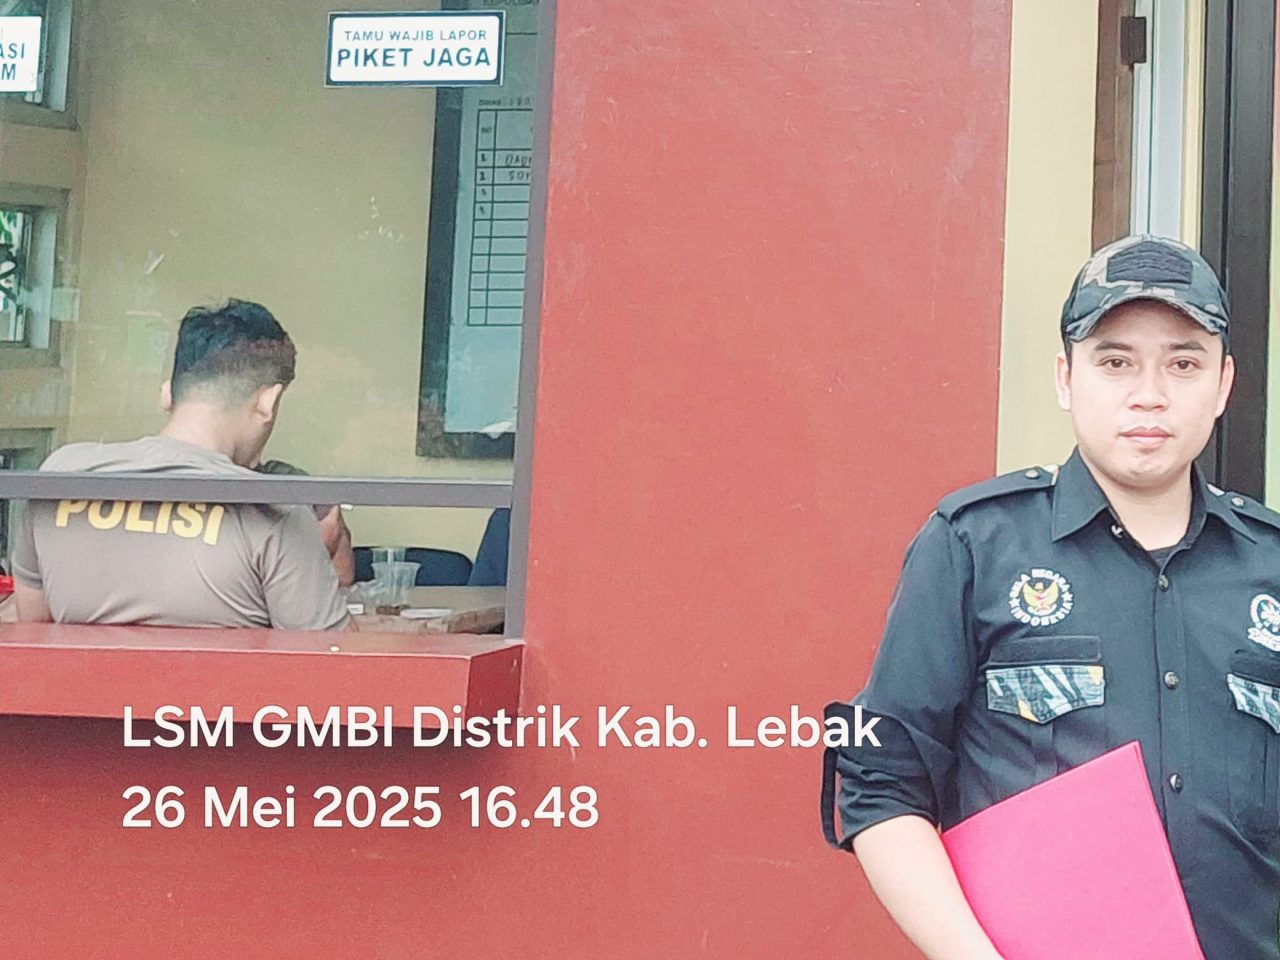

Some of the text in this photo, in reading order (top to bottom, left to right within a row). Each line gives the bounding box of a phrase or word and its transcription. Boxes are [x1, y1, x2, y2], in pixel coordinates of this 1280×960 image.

[344, 29, 488, 42] TAMU WAJIB LAPOR
[336, 47, 492, 68] PIKET JAGA
[55, 499, 225, 546] POLISI
